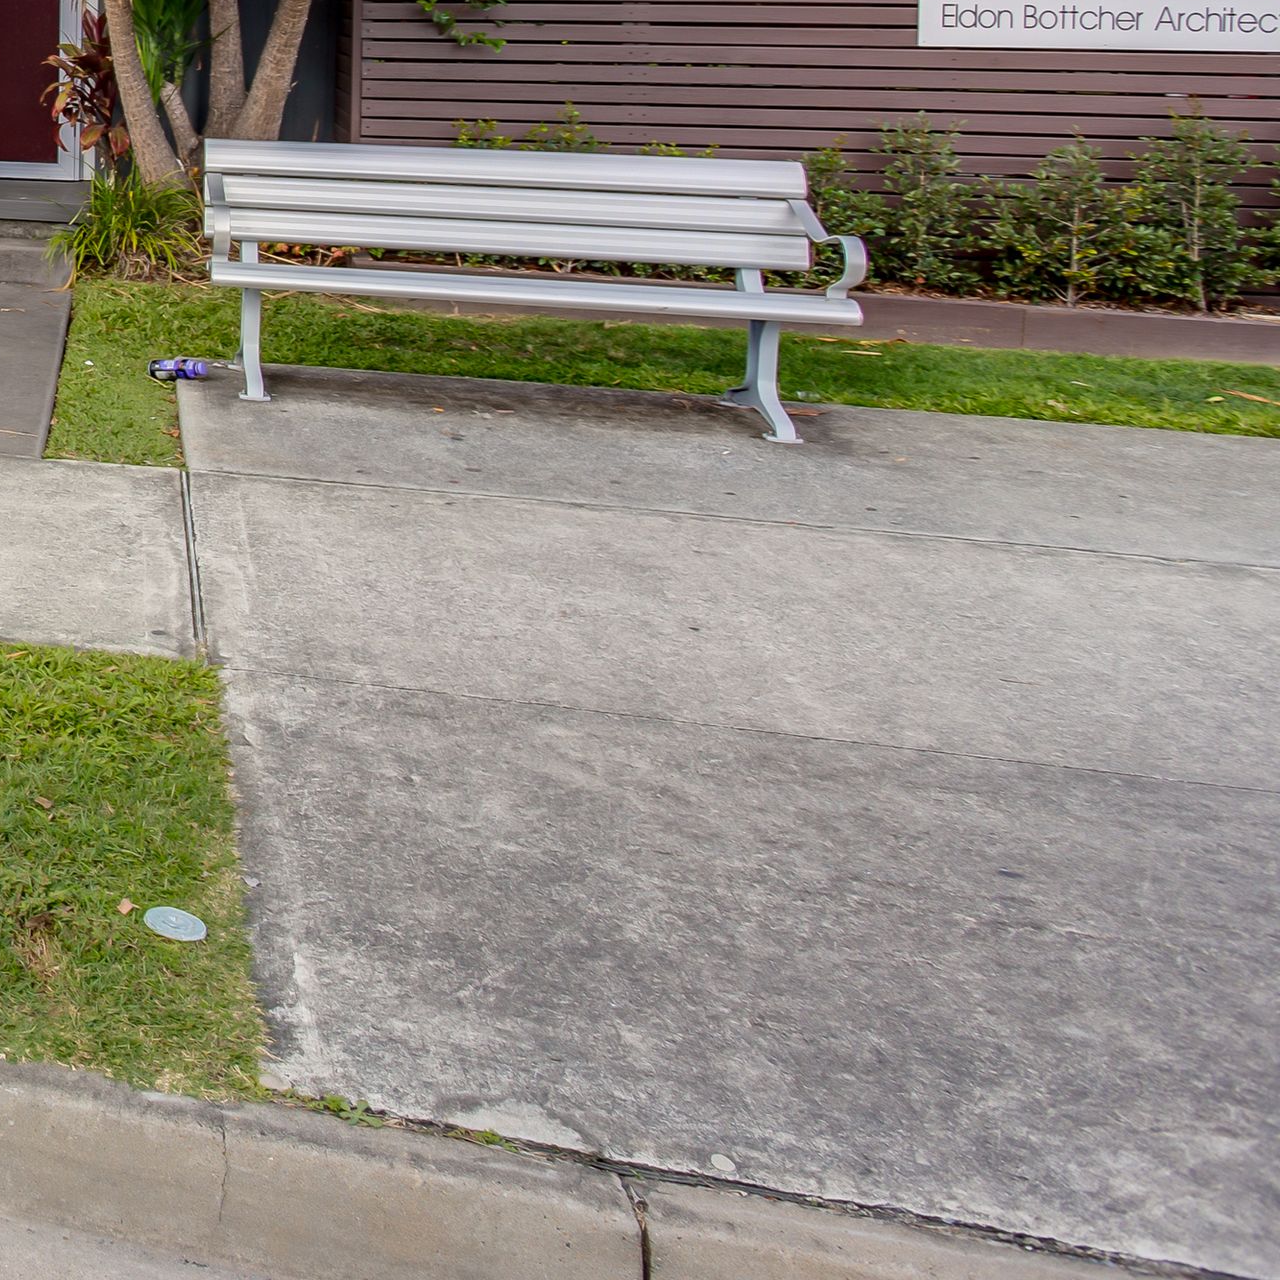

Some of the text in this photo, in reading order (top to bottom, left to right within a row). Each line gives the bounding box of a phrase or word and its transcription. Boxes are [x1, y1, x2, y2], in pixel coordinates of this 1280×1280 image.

[941, 3, 1280, 34] Eldon Bottcher Architec
